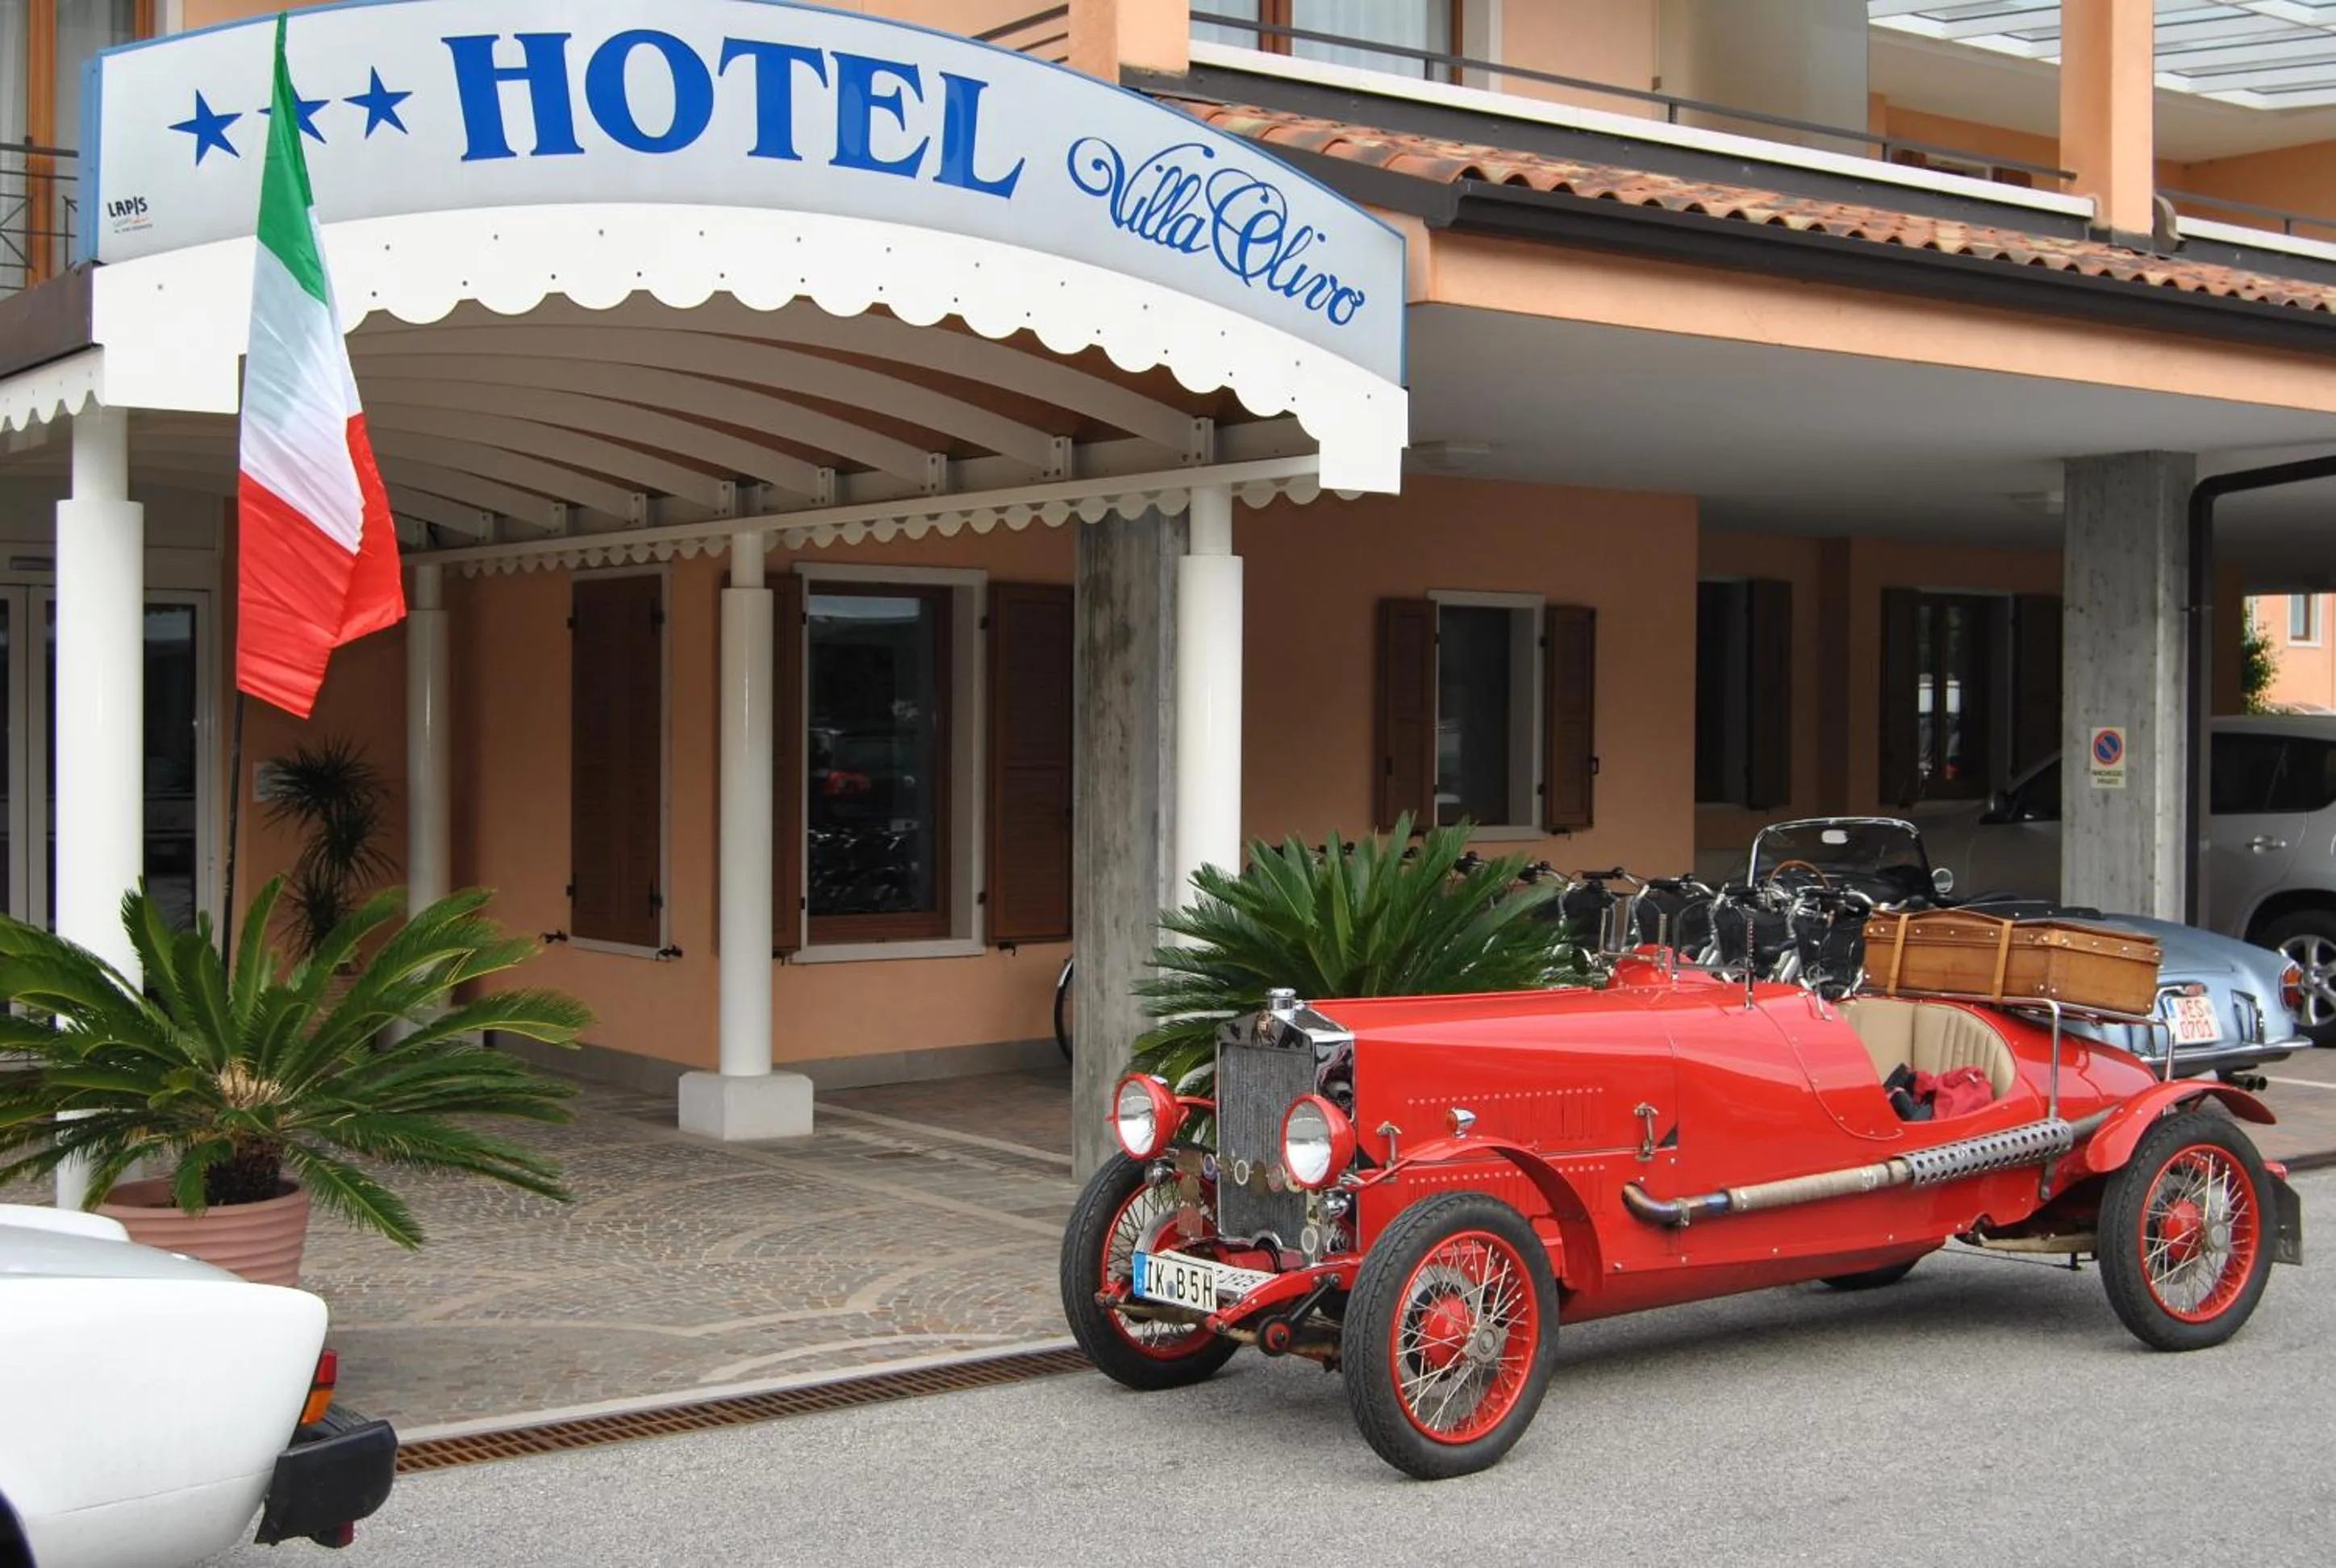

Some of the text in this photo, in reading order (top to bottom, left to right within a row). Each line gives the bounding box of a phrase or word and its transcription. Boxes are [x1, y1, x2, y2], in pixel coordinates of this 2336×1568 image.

[441, 30, 1366, 326] HOTEL Villa Olivo
[107, 196, 148, 218] LAPIS
[1146, 1261, 1166, 1297] IK
[1176, 1267, 1213, 1308] B5H
